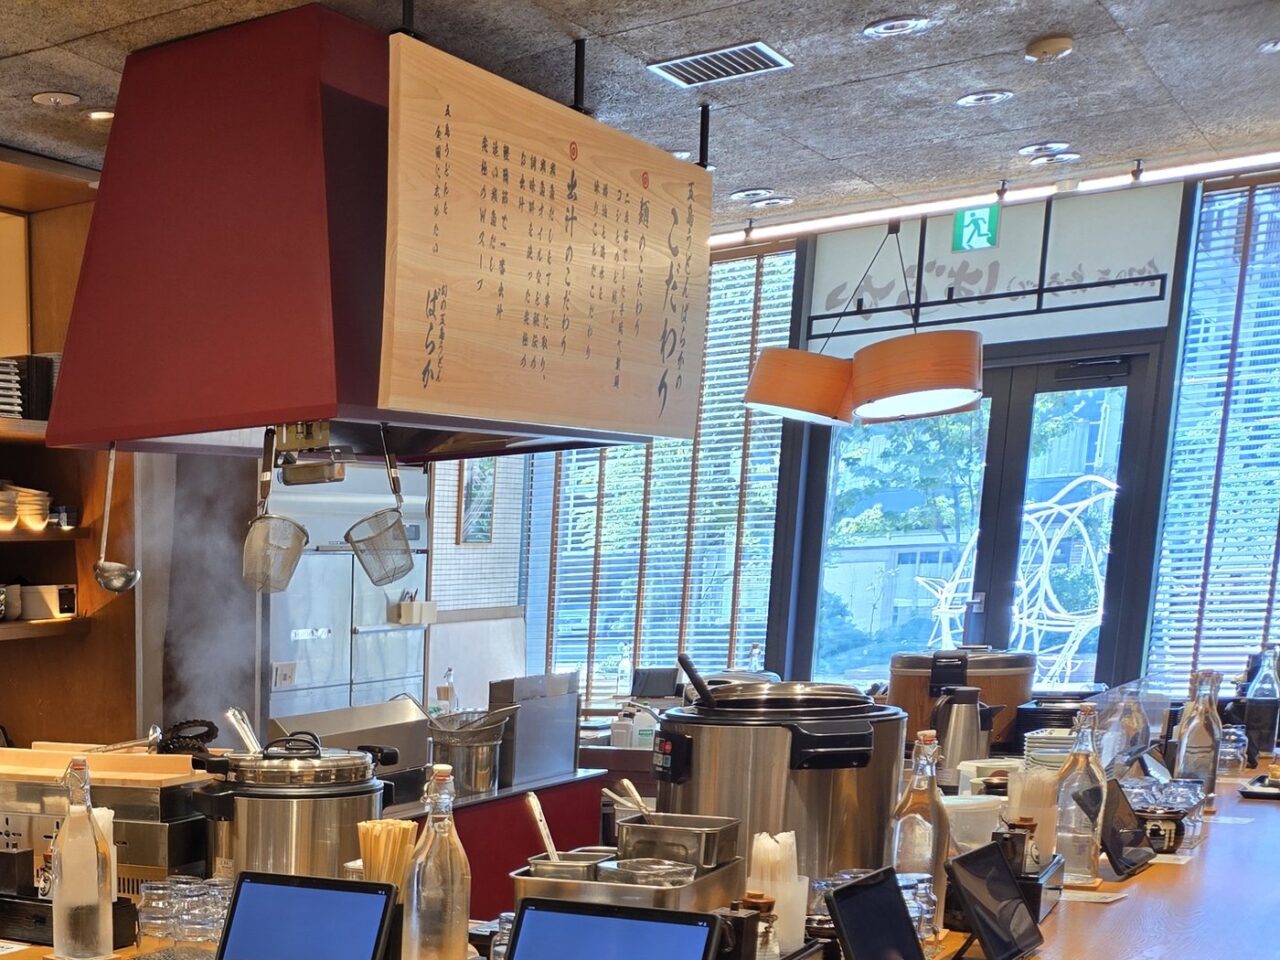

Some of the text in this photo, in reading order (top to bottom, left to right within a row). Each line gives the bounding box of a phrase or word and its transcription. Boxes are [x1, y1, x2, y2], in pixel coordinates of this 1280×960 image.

[421, 286, 441, 390] ばらか
[560, 168, 578, 357] 出汁のこだわり
[658, 207, 681, 419] こだわり
